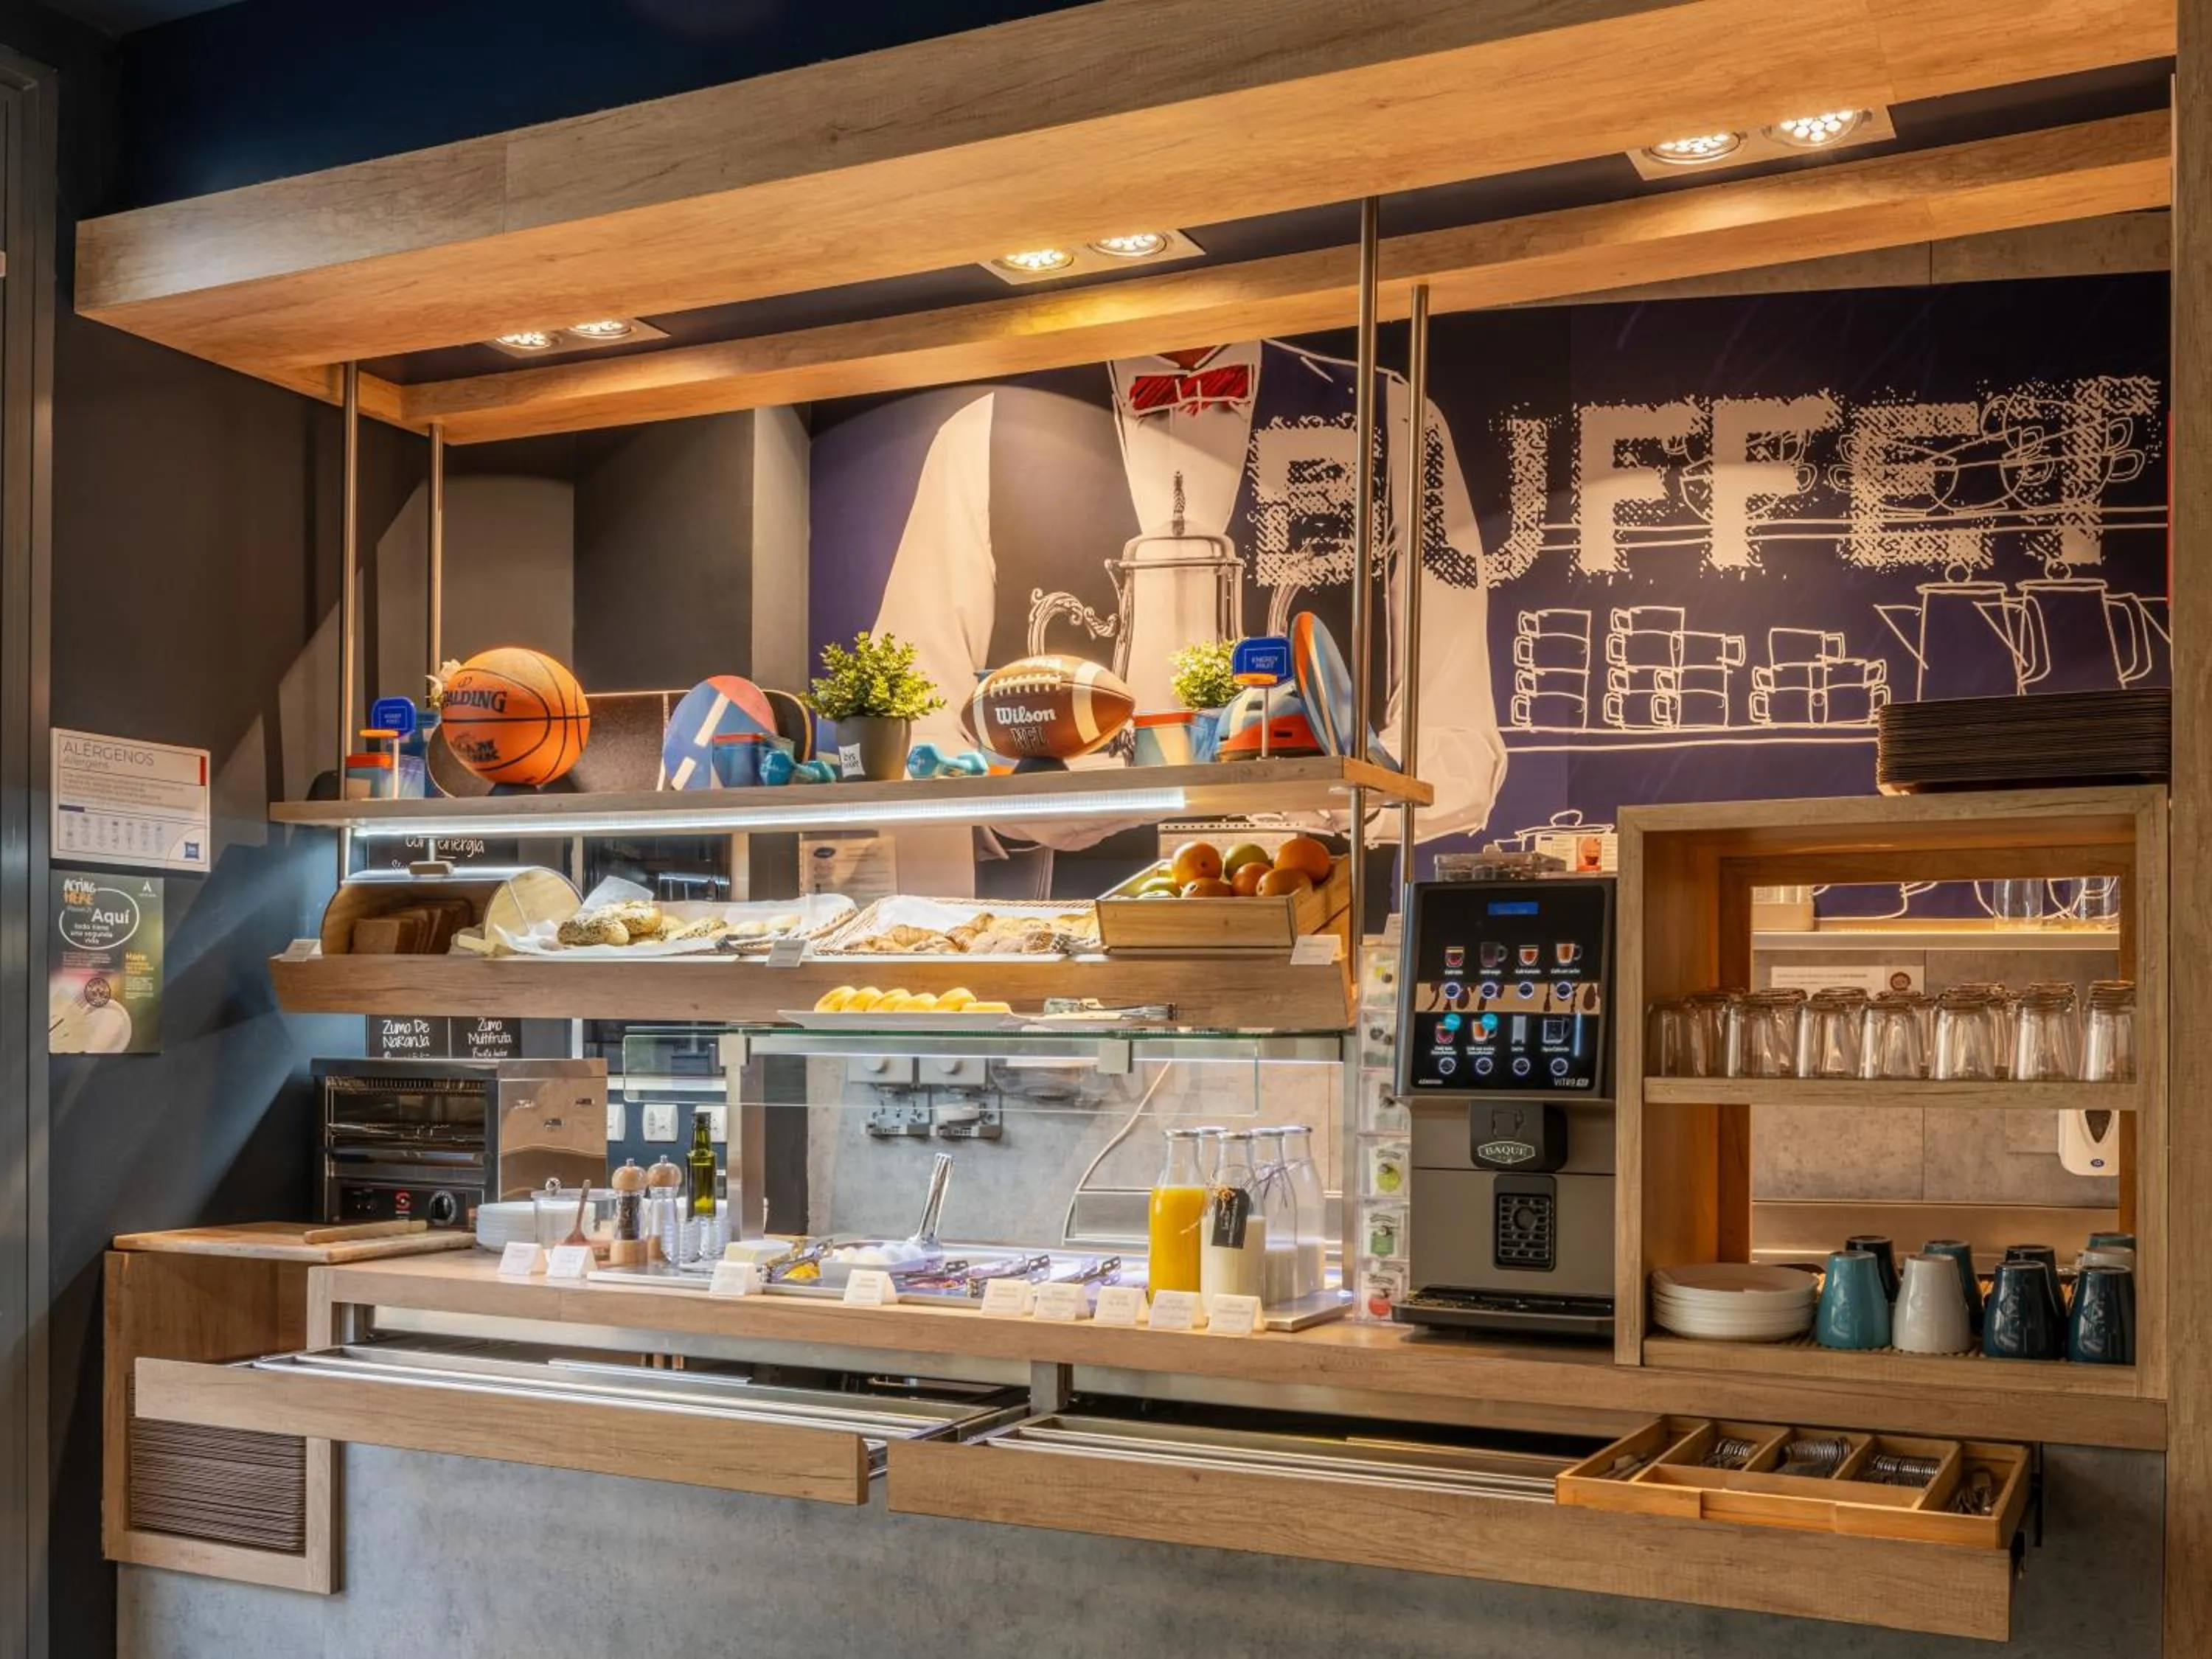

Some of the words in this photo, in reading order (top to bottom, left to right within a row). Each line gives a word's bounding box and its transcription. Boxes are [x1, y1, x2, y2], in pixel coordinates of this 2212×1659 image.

[1248, 375, 2162, 590] BUFFET
[995, 706, 1056, 725] Wilson
[91, 908, 131, 926] Aquí
